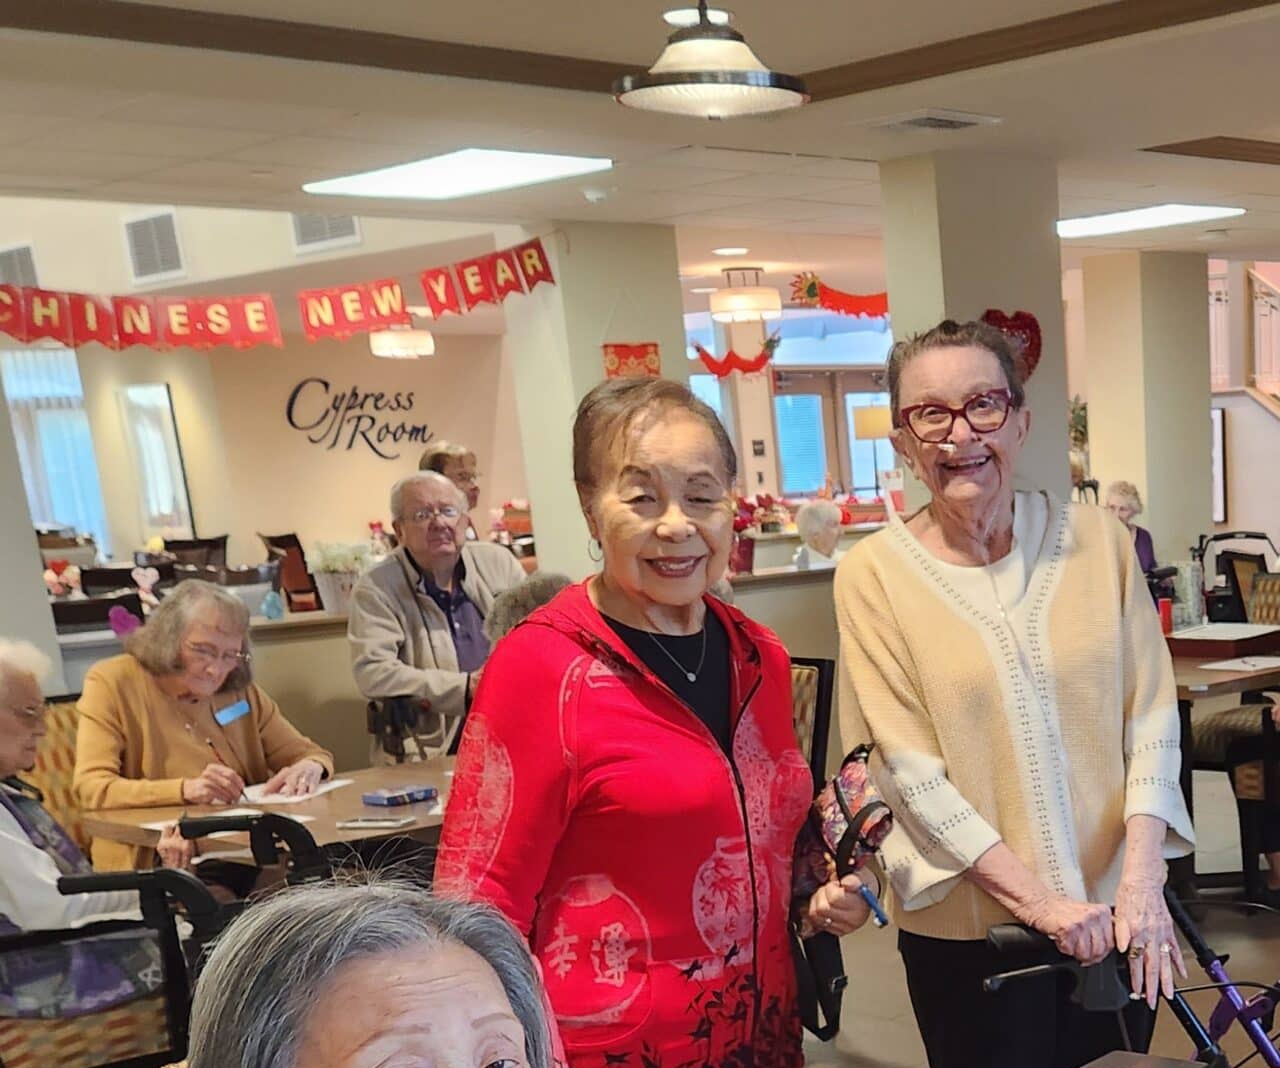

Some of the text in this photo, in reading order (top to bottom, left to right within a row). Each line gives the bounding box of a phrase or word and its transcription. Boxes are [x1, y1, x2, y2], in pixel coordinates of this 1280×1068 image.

[307, 284, 401, 328] NEW
[428, 248, 544, 304] YEAR
[286, 377, 415, 450] Cypress
[346, 414, 434, 460] Room
